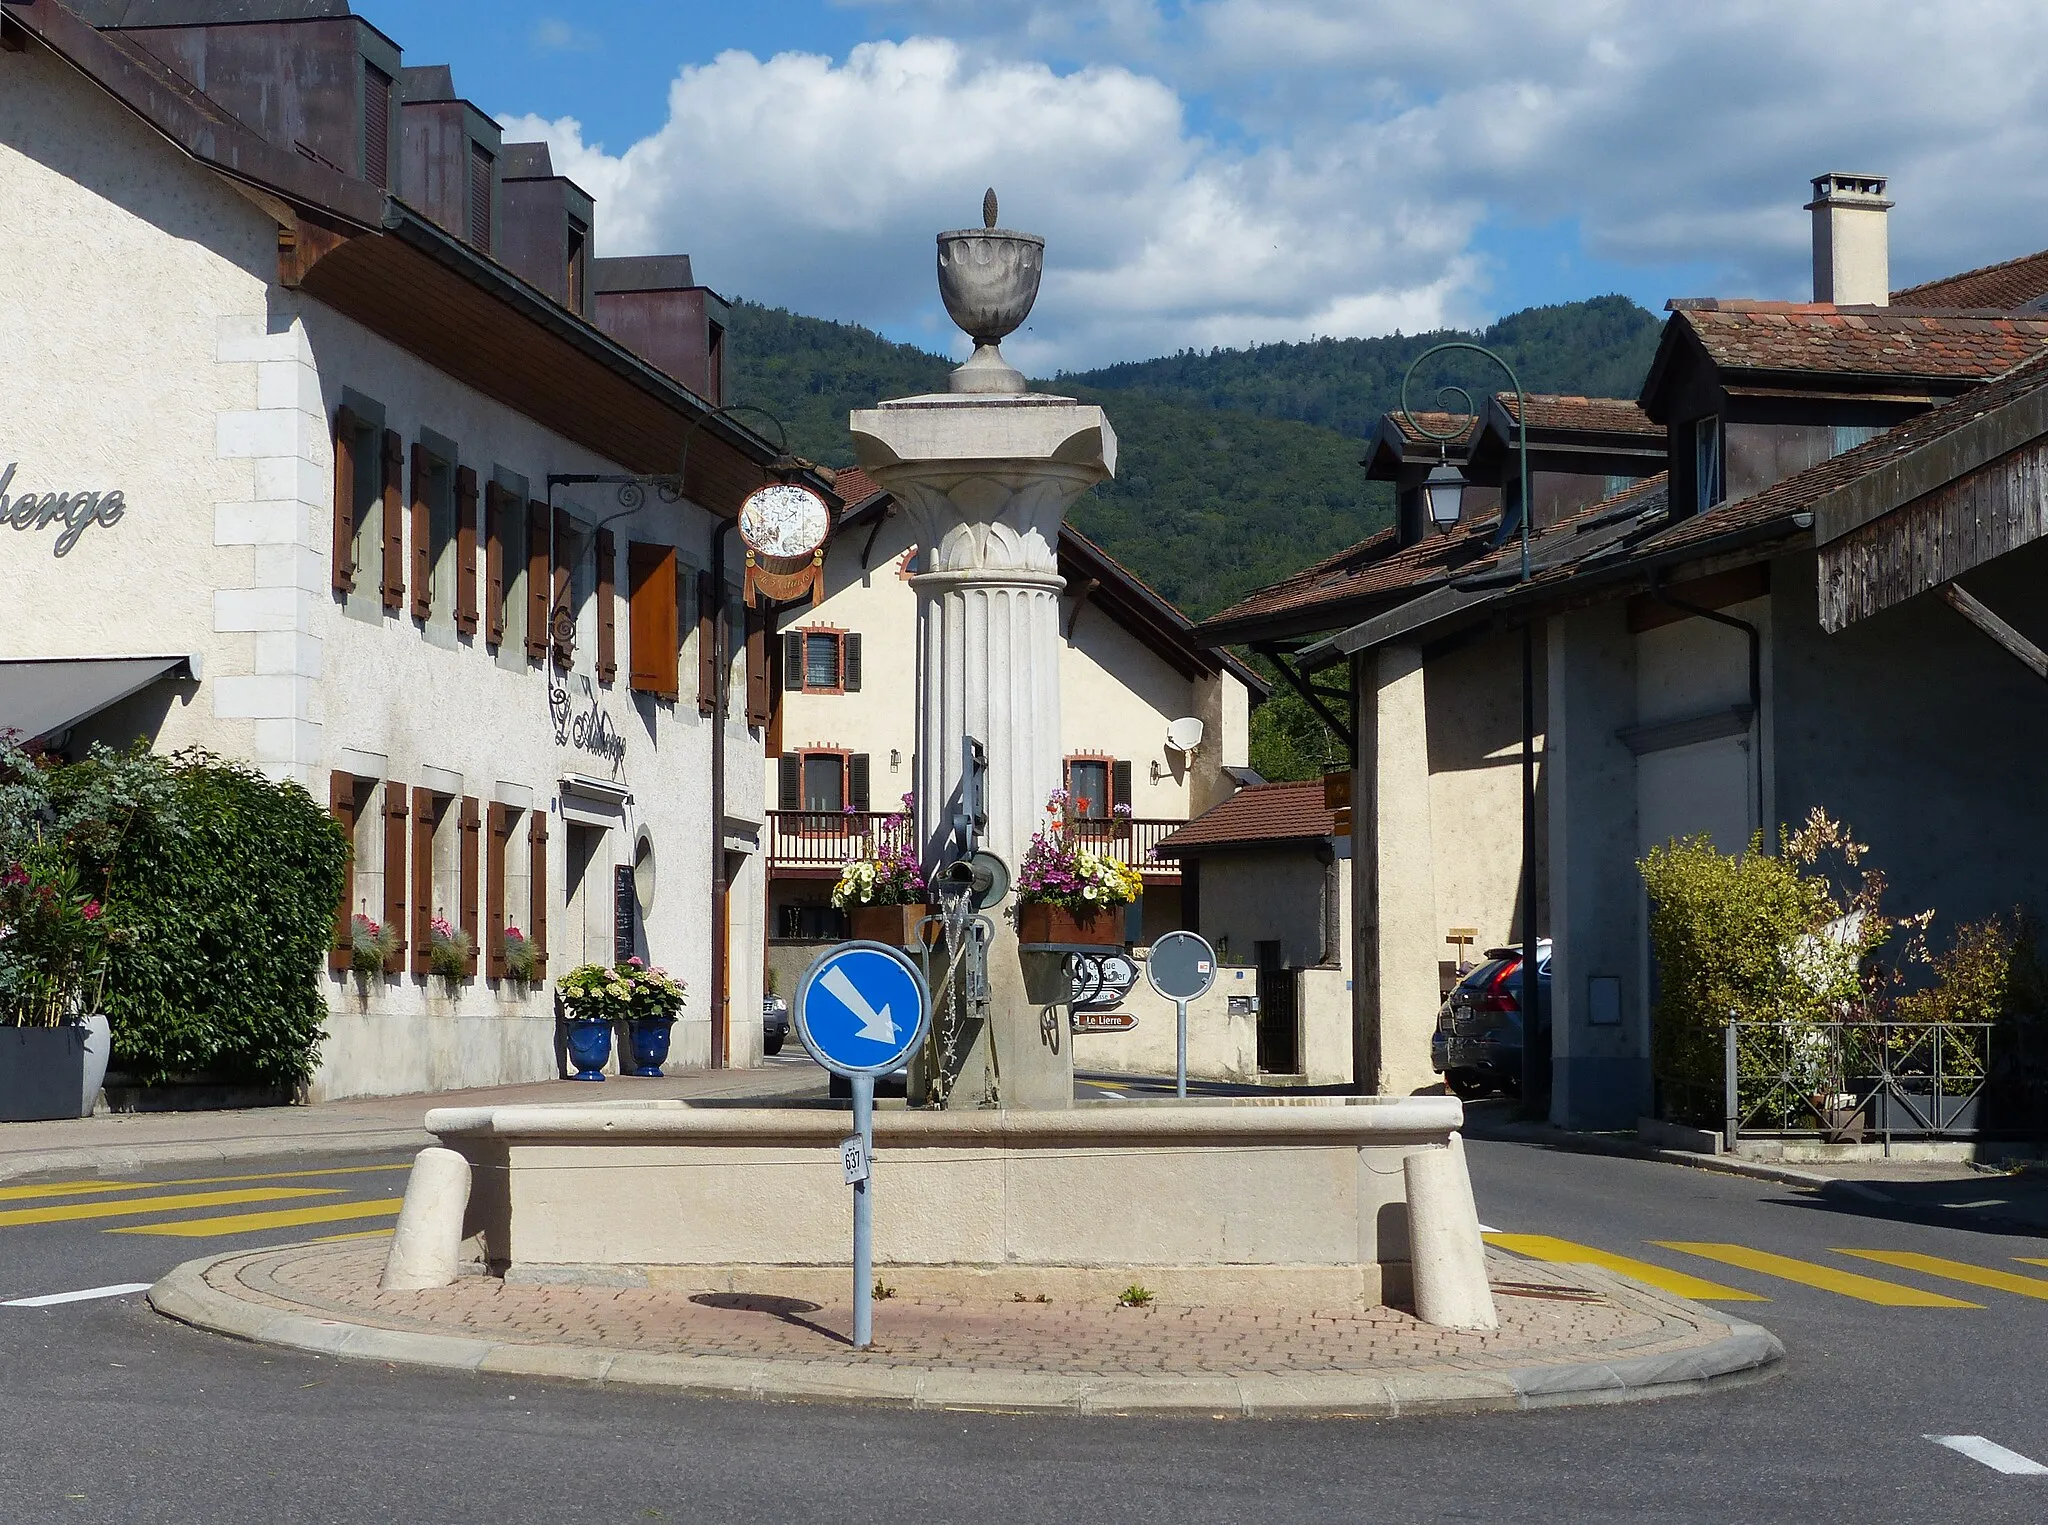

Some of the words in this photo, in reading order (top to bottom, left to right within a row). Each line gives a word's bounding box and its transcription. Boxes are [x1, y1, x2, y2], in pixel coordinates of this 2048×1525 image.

[1086, 1015, 1096, 1025] Le
[1098, 1015, 1122, 1025] Lierre
[845, 1150, 860, 1170] 637
